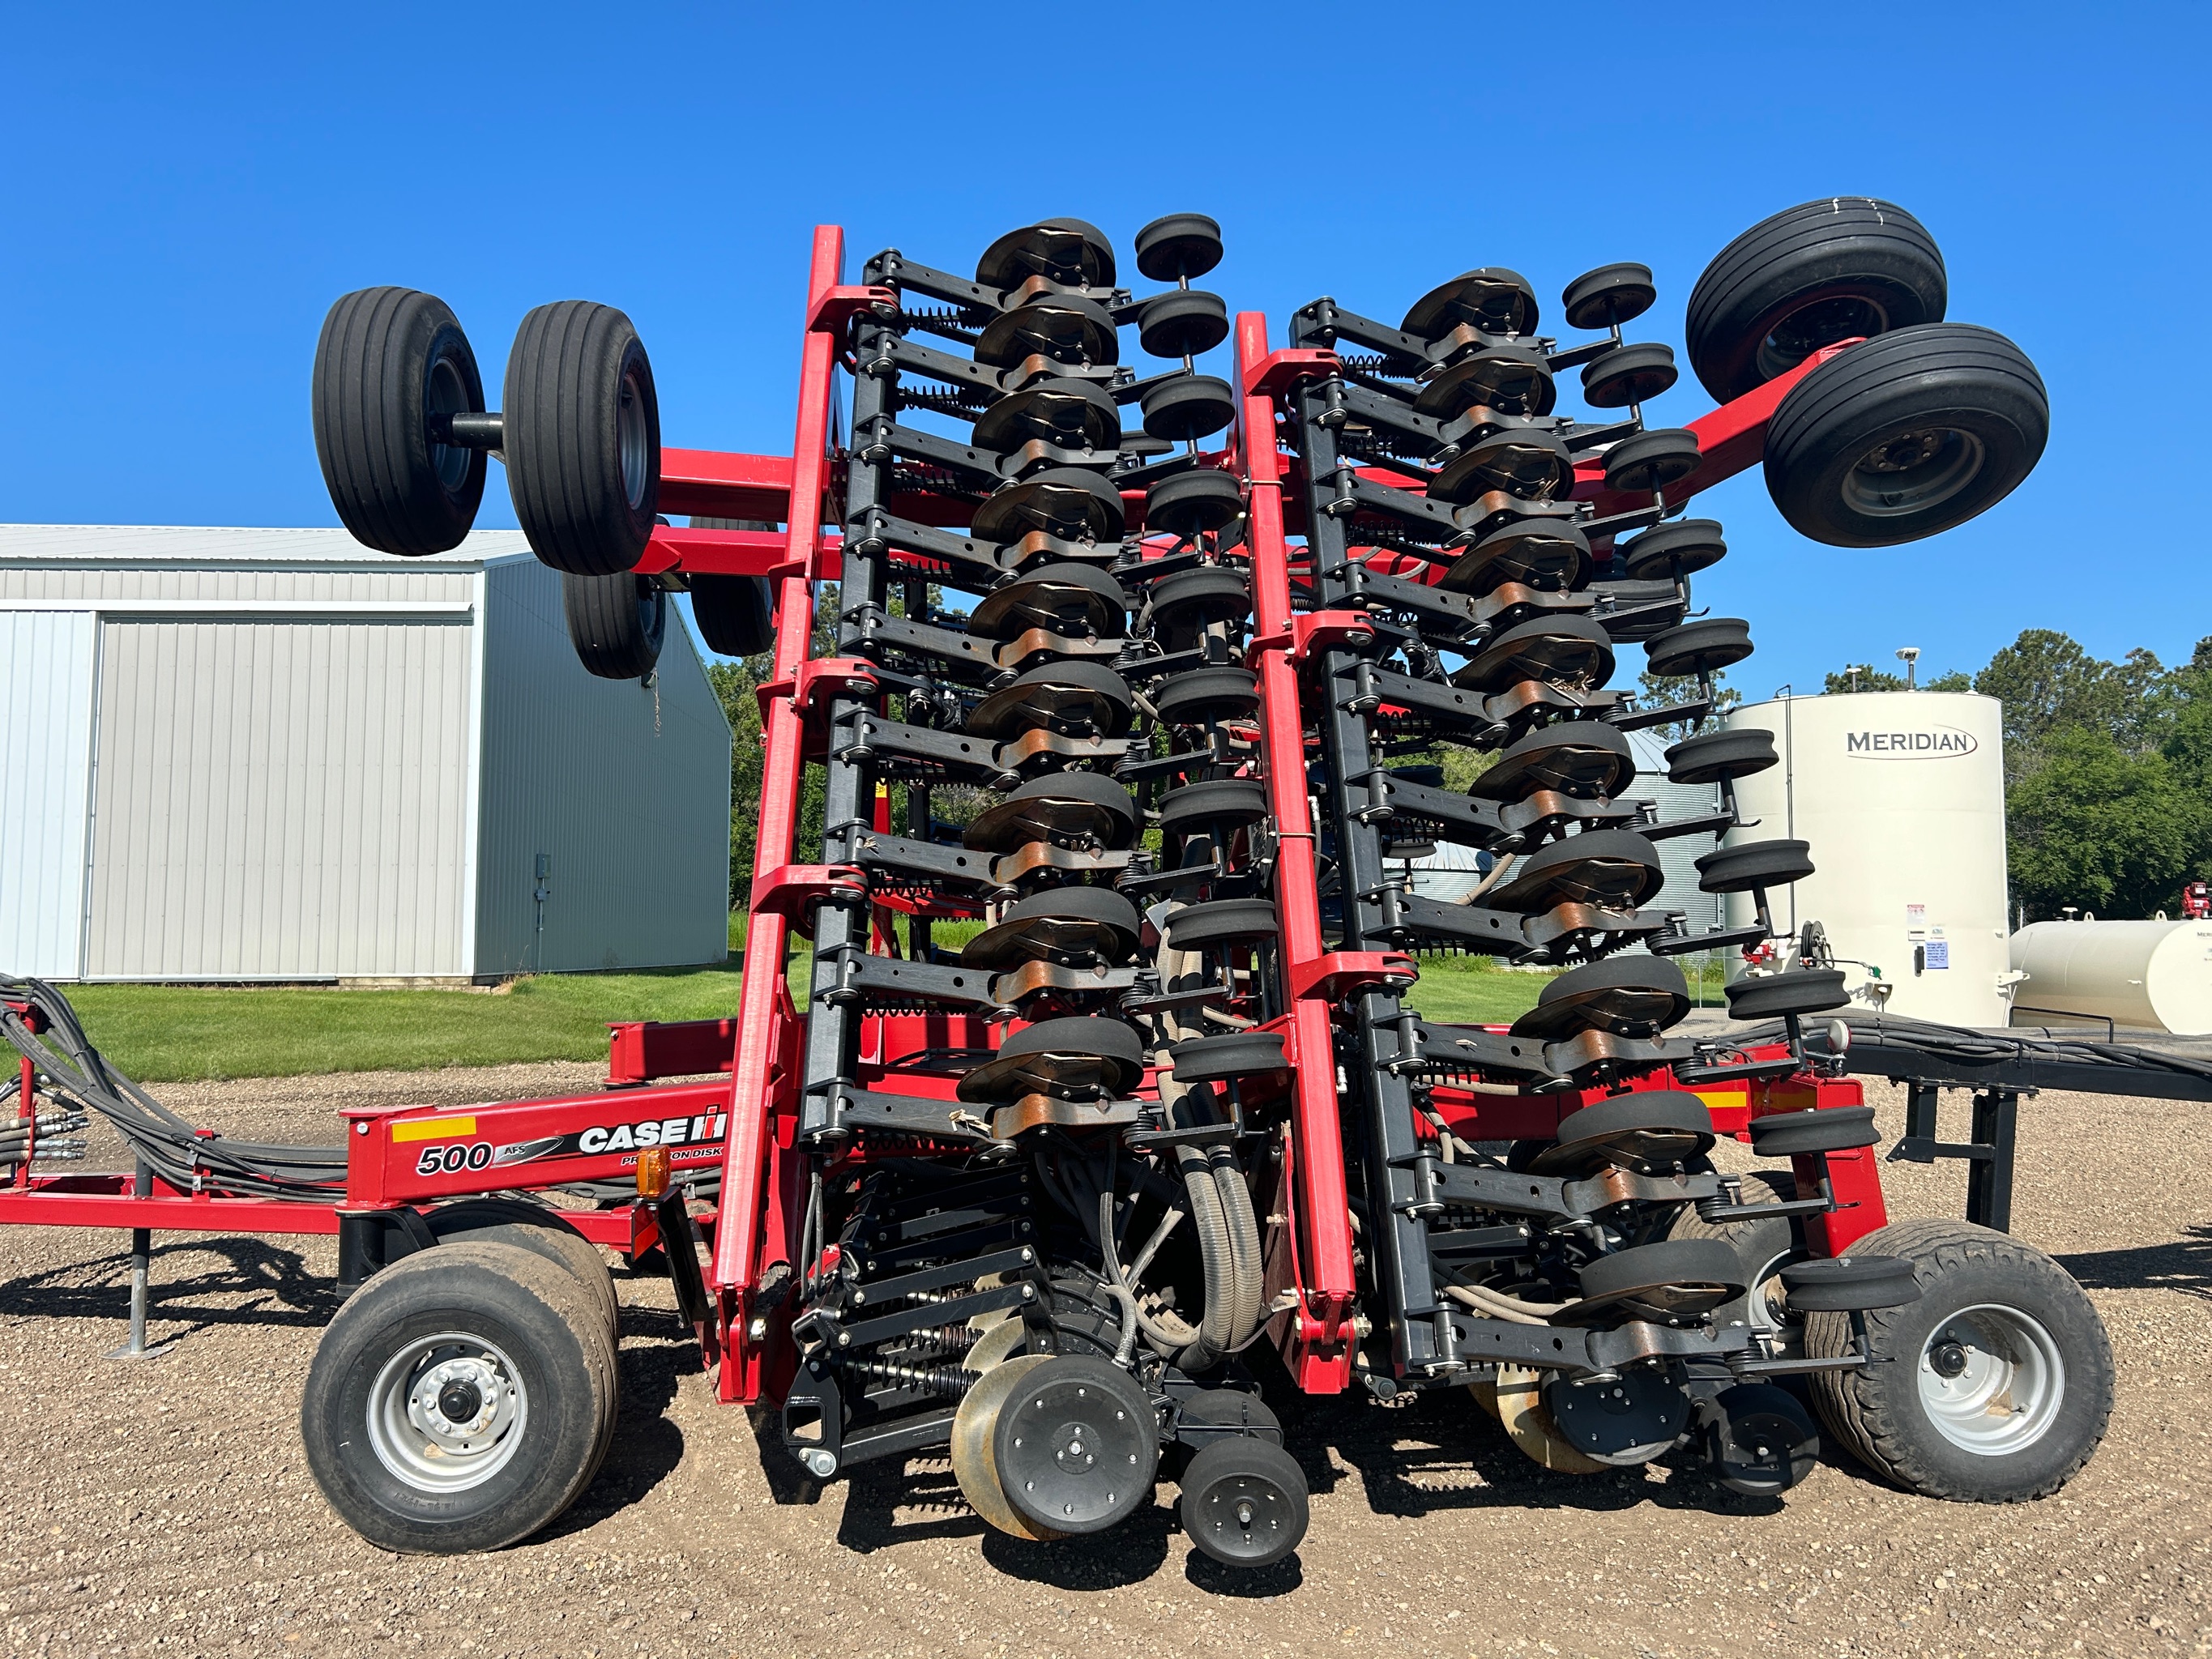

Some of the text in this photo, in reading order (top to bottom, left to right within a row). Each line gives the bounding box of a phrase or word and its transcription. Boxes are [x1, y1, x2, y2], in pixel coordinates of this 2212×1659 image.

[1847, 731, 1967, 752] MERIDIAN
[579, 1118, 689, 1154] CASE
[416, 1142, 493, 1176] 500
[504, 1145, 527, 1156] AFS
[691, 1146, 724, 1159] DISK
